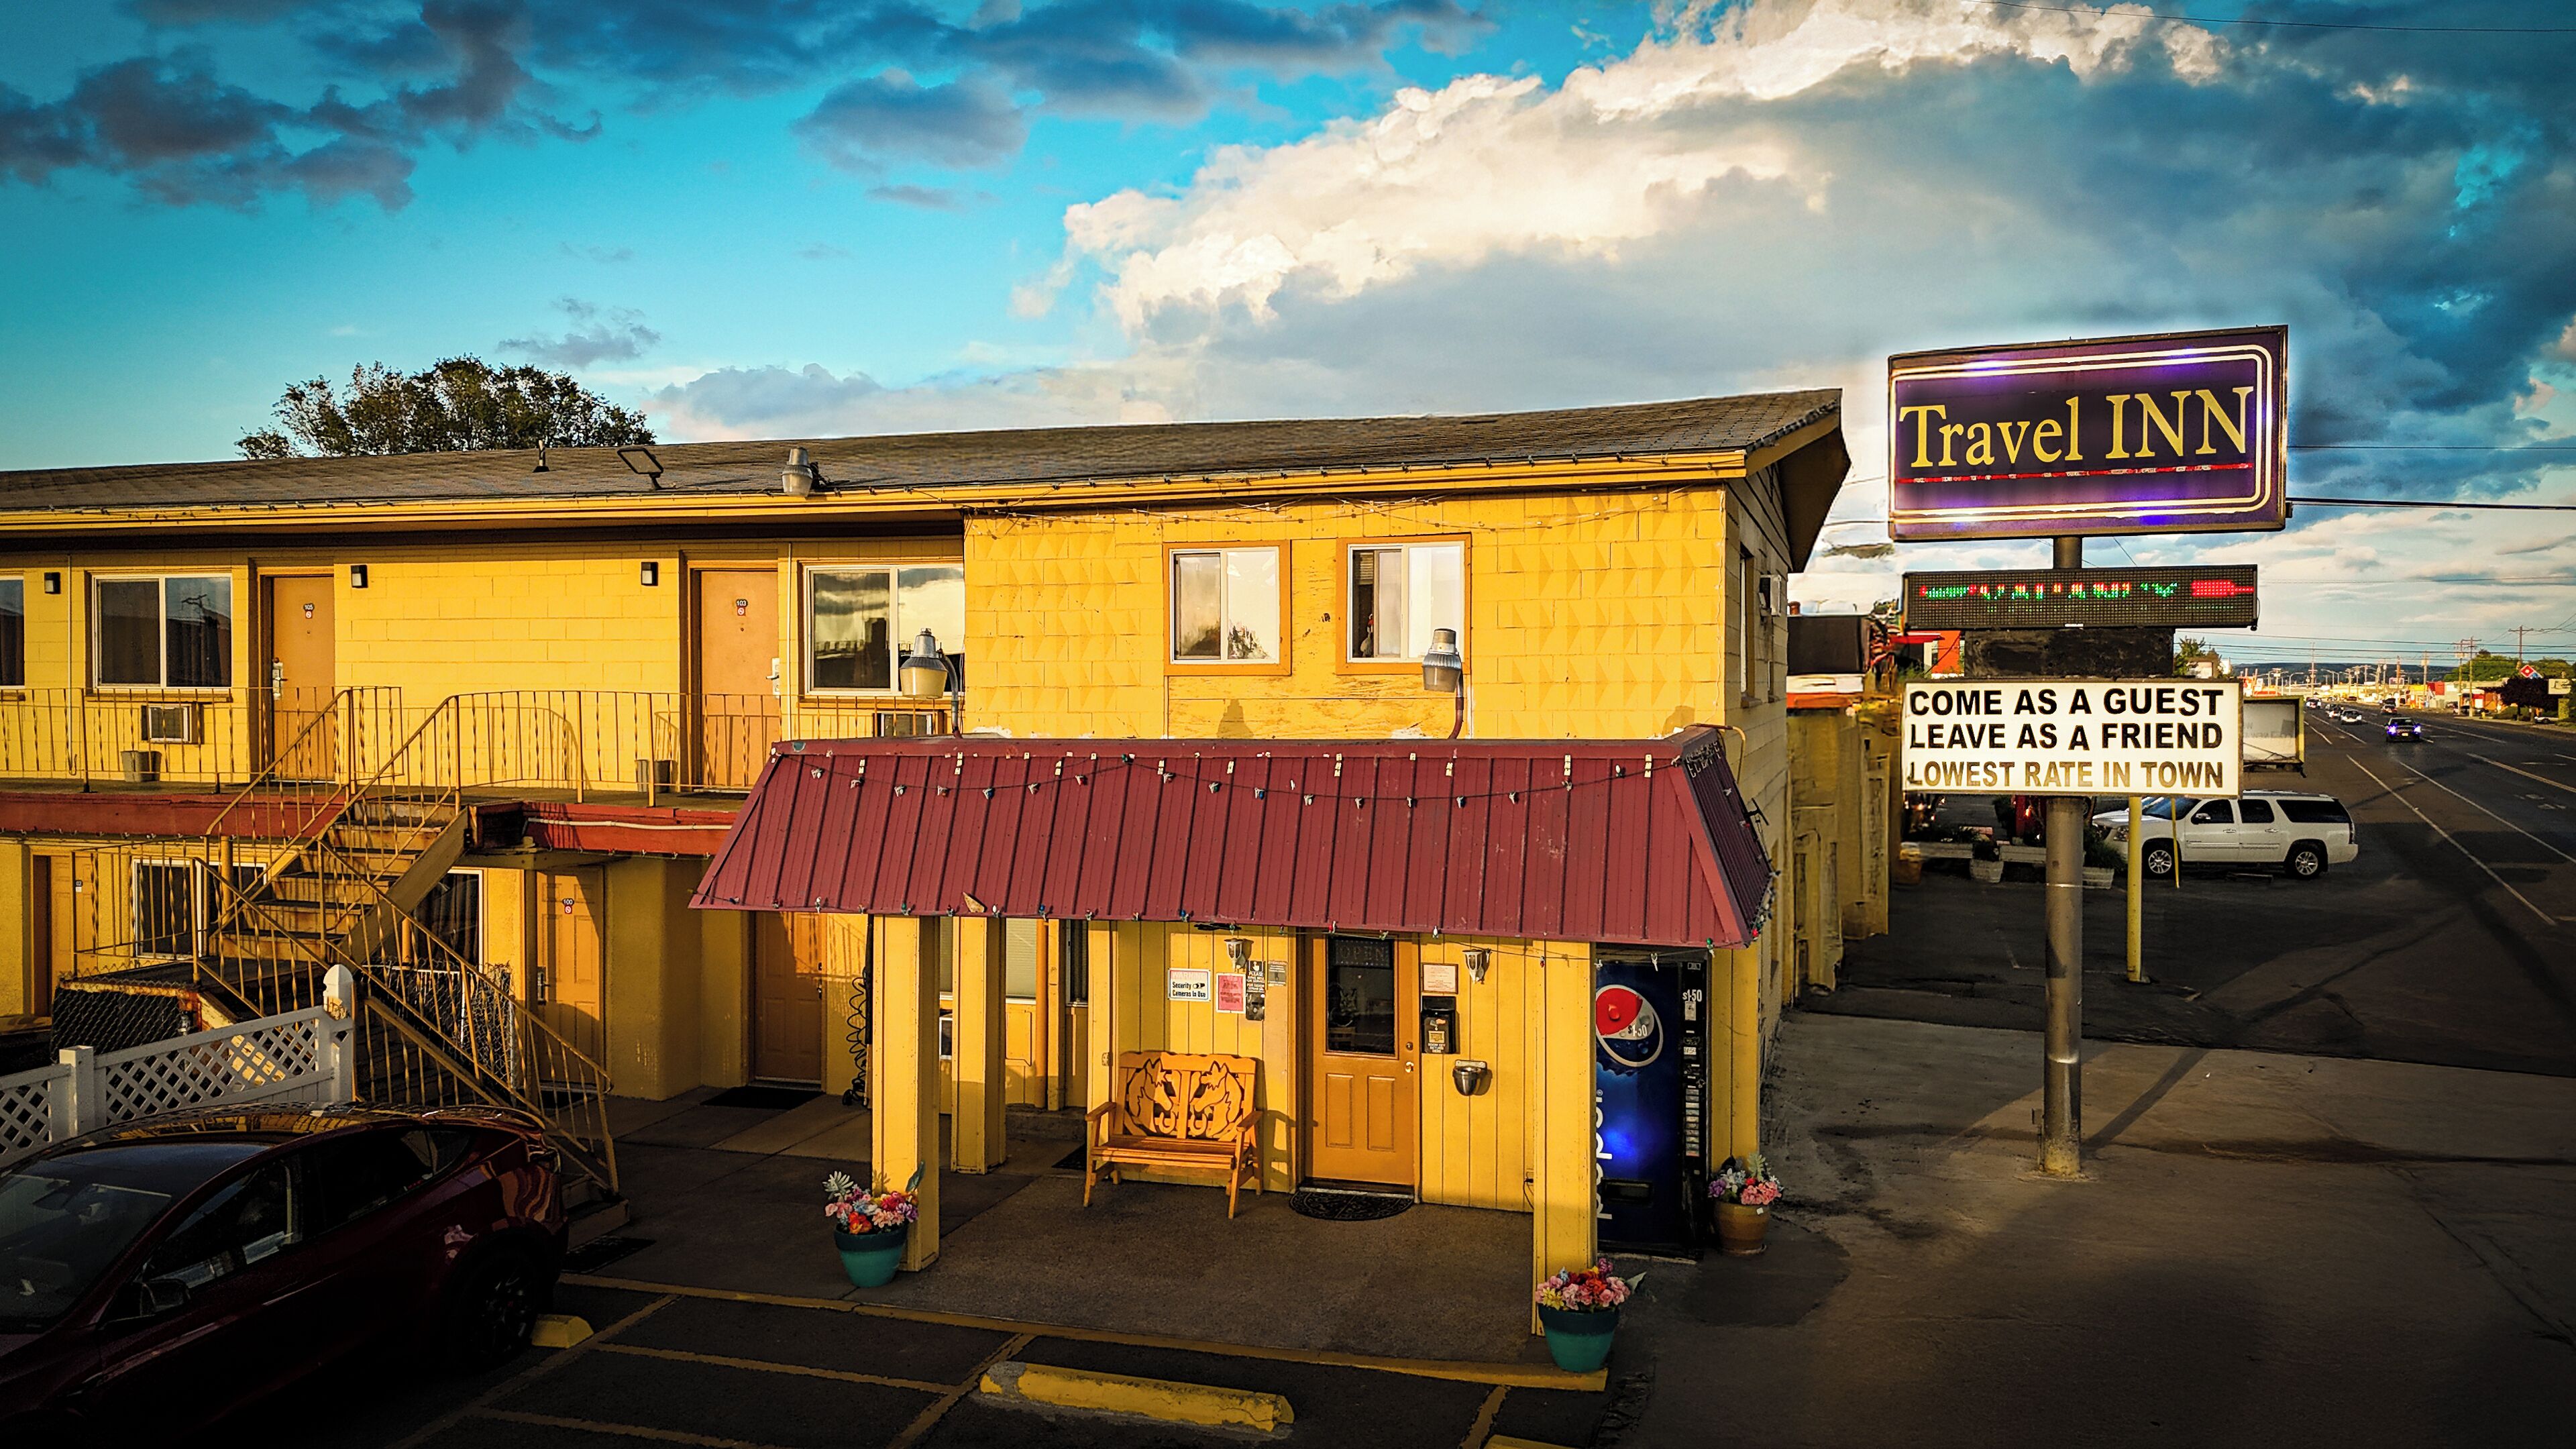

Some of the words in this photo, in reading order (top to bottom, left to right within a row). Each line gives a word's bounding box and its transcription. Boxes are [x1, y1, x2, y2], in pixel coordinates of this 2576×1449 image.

[1899, 396, 2083, 468] Travel
[2105, 386, 2254, 460] INN
[1910, 689, 2002, 716] COME
[2014, 689, 2057, 715] AS
[2070, 688, 2092, 715] A
[2104, 688, 2224, 716] GUEST
[1910, 723, 2006, 749] LEAVE
[2017, 723, 2057, 749] AS
[2068, 725, 2090, 751] A
[2102, 722, 2223, 749] FRIEND
[1908, 761, 2015, 787] LOWEST
[2025, 761, 2093, 788] RATE
[2104, 761, 2131, 788] IN
[2141, 761, 2223, 788] TOWN
[1340, 945, 1385, 961] OPEN
[1172, 981, 1191, 989] Security
